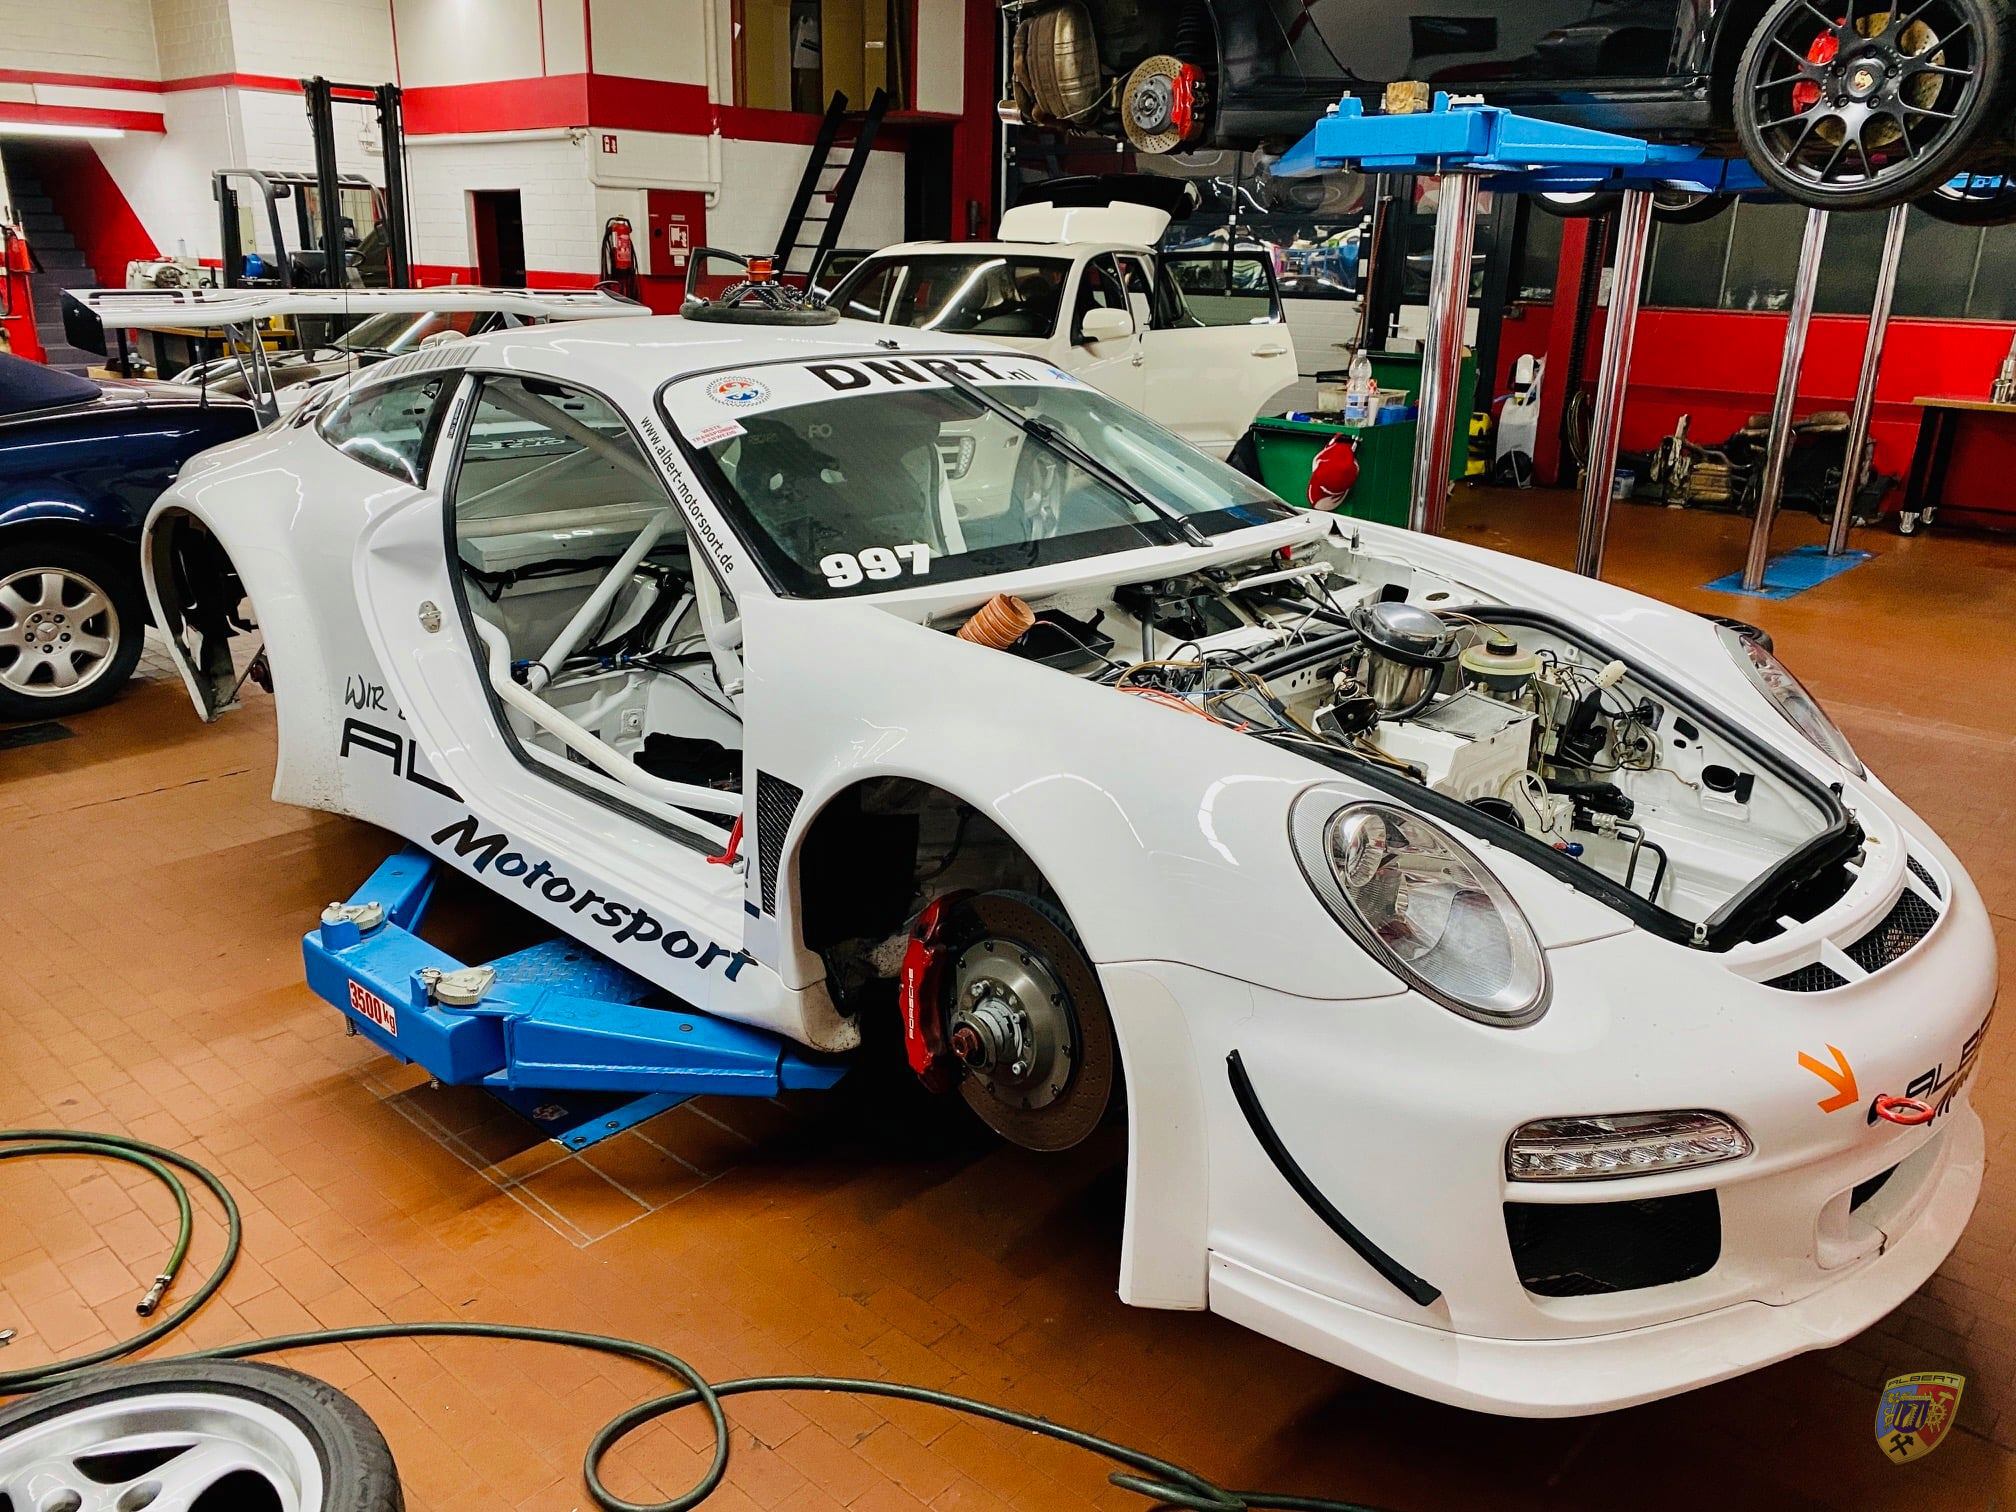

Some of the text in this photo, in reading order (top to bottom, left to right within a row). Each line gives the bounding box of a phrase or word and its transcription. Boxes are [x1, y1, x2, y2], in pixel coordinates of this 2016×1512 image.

[640, 416, 735, 574] www.albert-motorsport.de
[819, 542, 931, 588] 997
[345, 673, 388, 711] WIR
[430, 814, 759, 983] Motorsport
[349, 982, 397, 1035] 3500 kg
